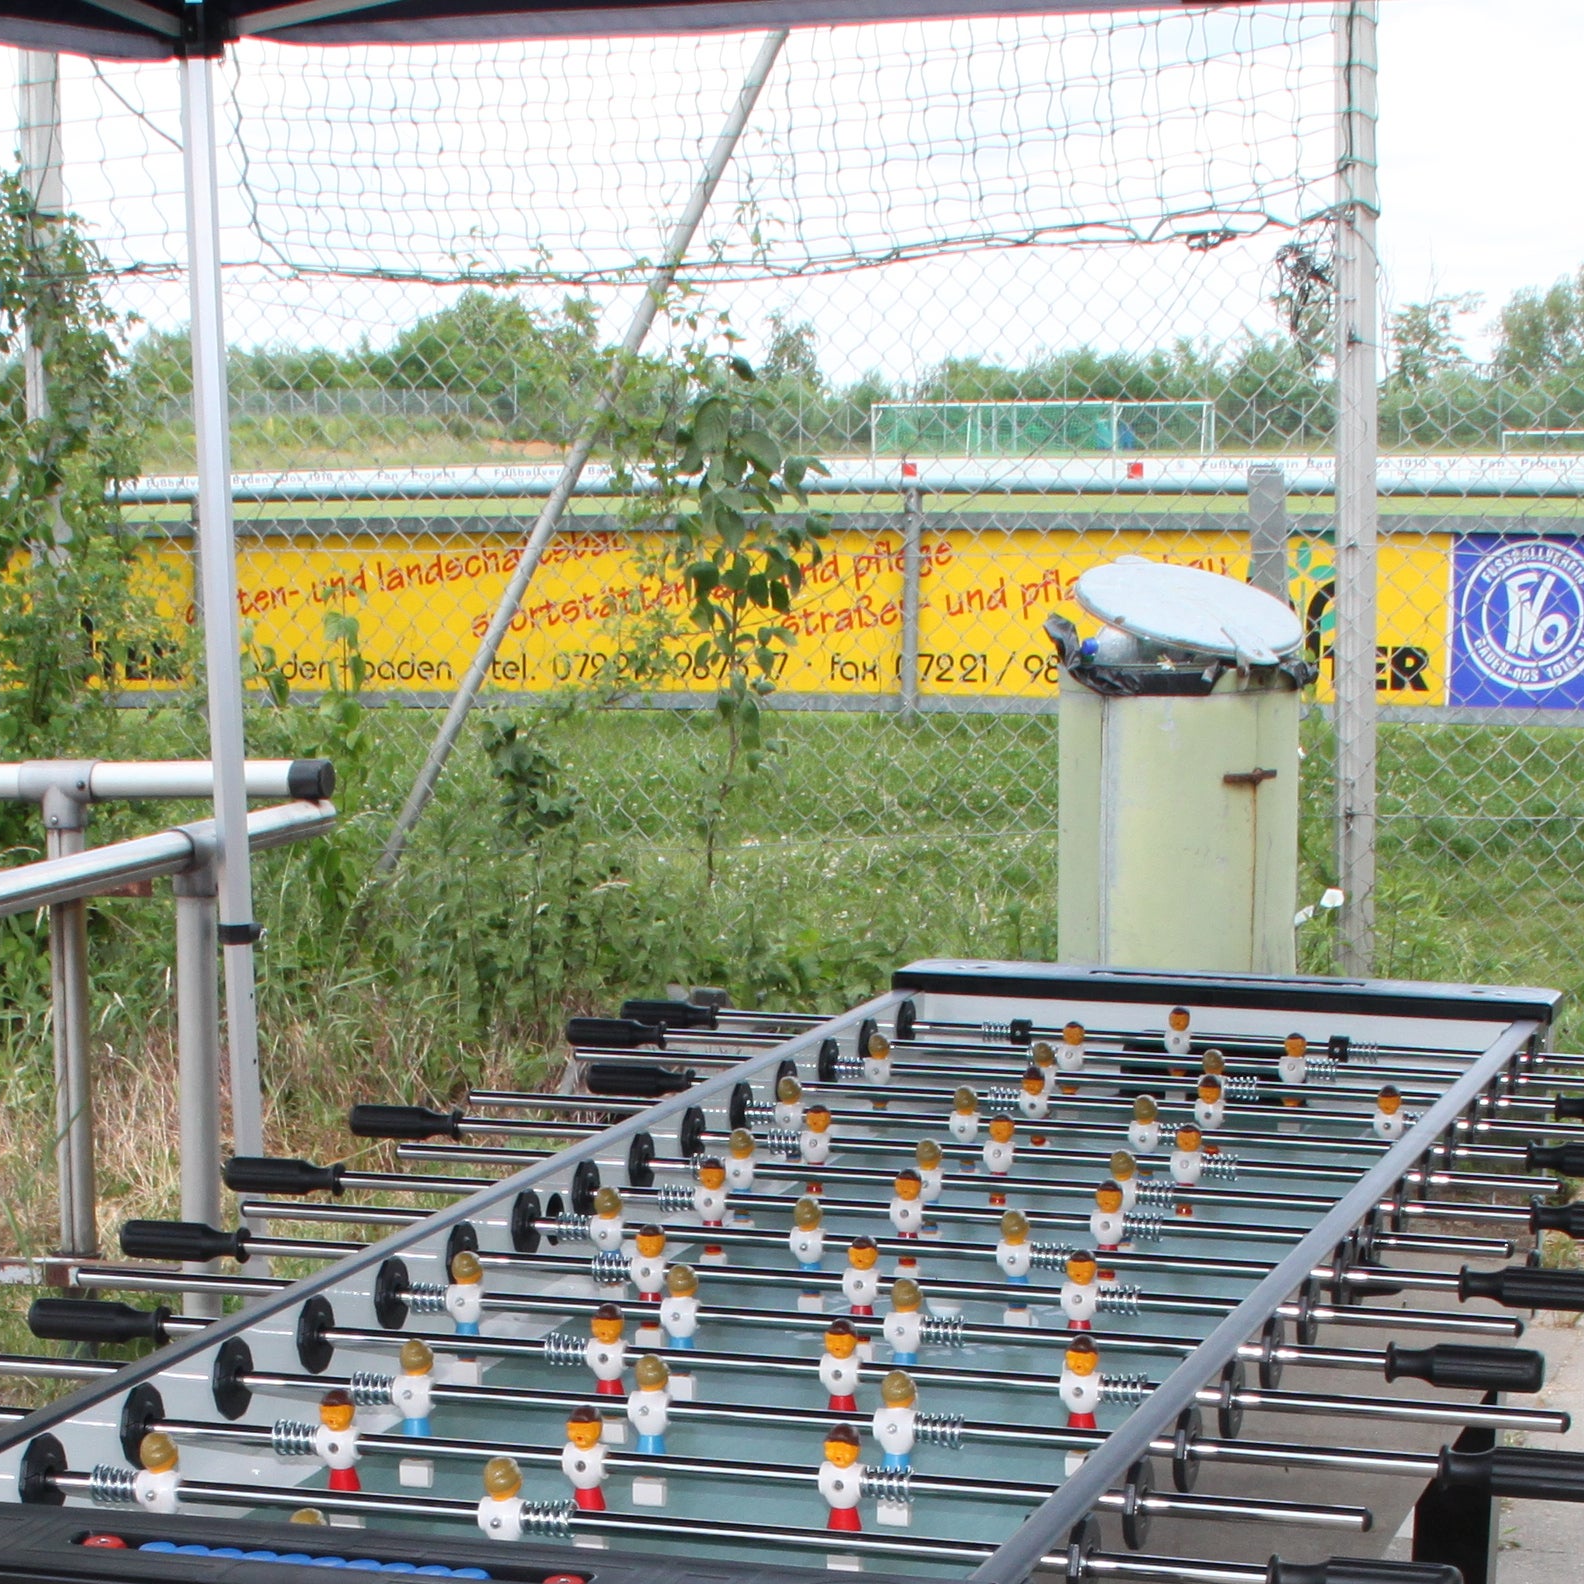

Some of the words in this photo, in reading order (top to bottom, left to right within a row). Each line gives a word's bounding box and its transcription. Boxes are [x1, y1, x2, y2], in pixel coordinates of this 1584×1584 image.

[780, 594, 931, 637] straße-
[945, 577, 1008, 618] und
[830, 652, 878, 682] fax
